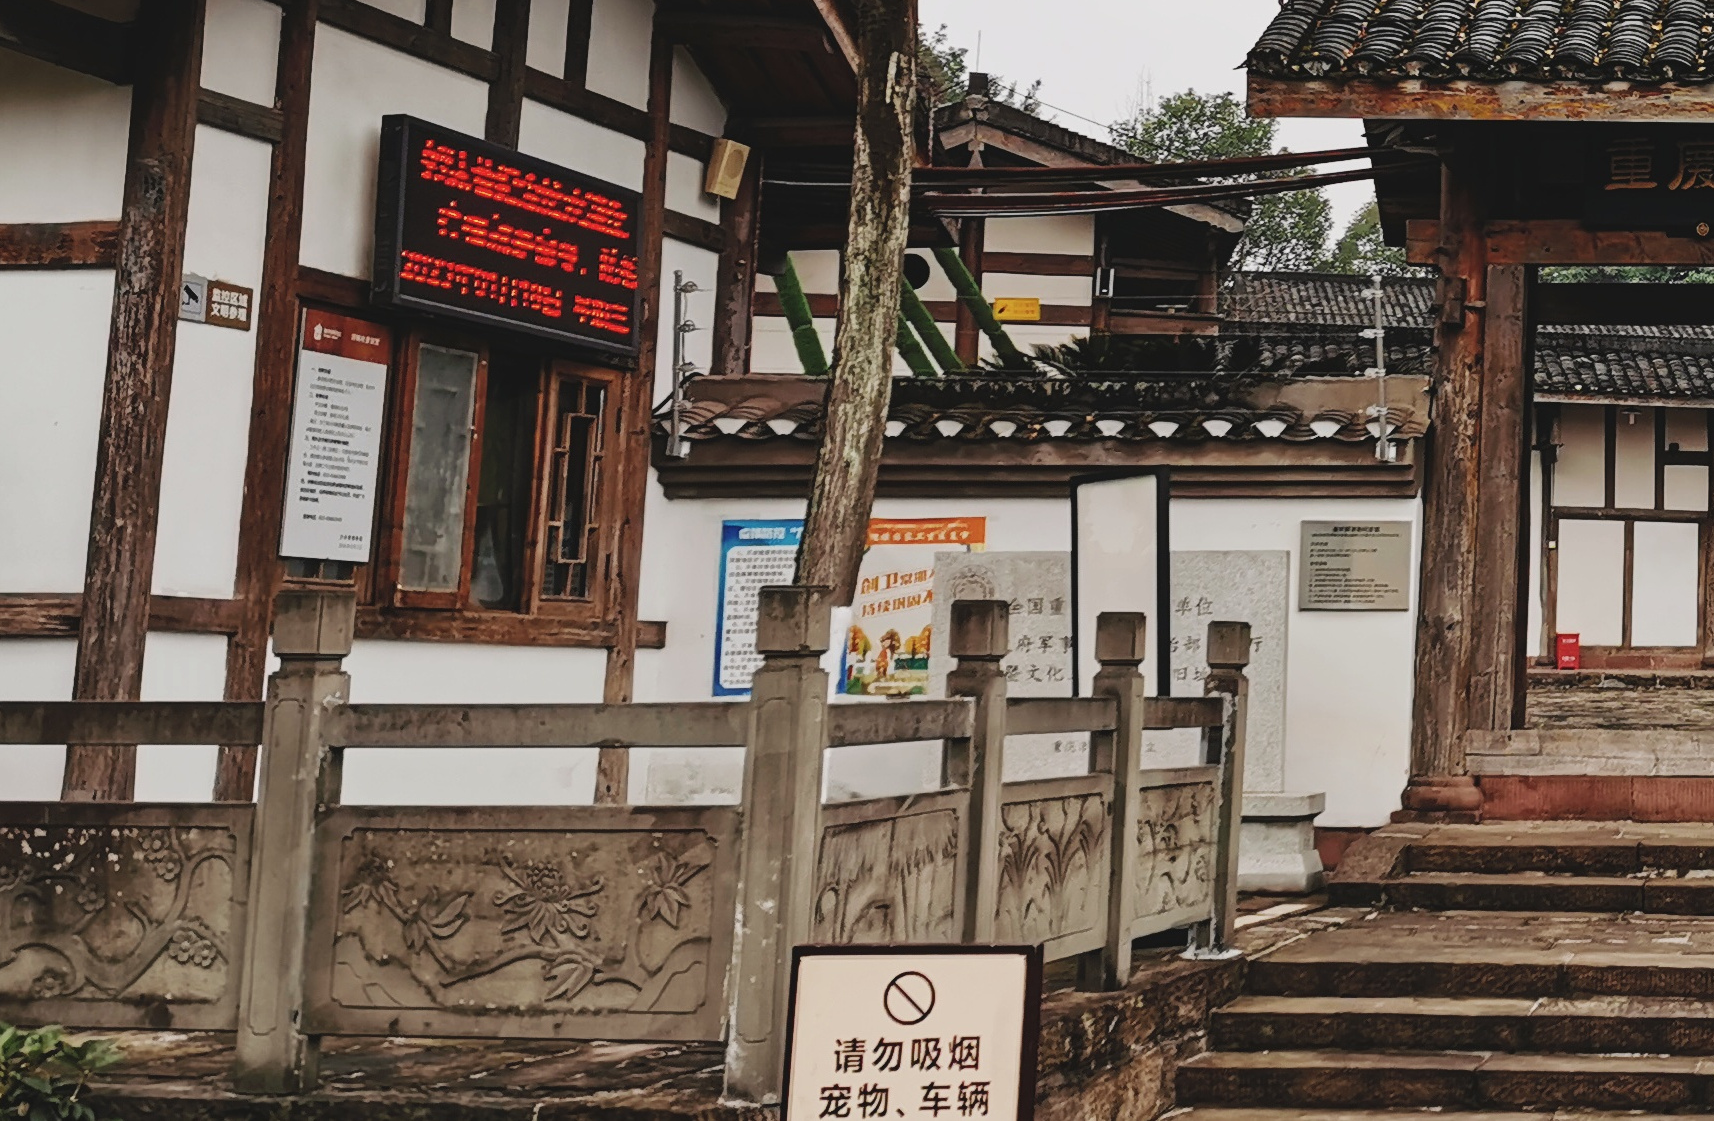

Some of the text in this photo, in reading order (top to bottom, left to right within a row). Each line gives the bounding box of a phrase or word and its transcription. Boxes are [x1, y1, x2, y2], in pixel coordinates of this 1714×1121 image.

[833, 1035, 980, 1073] 请勿吸烟
[818, 1080, 991, 1120] 宠物、车辆
